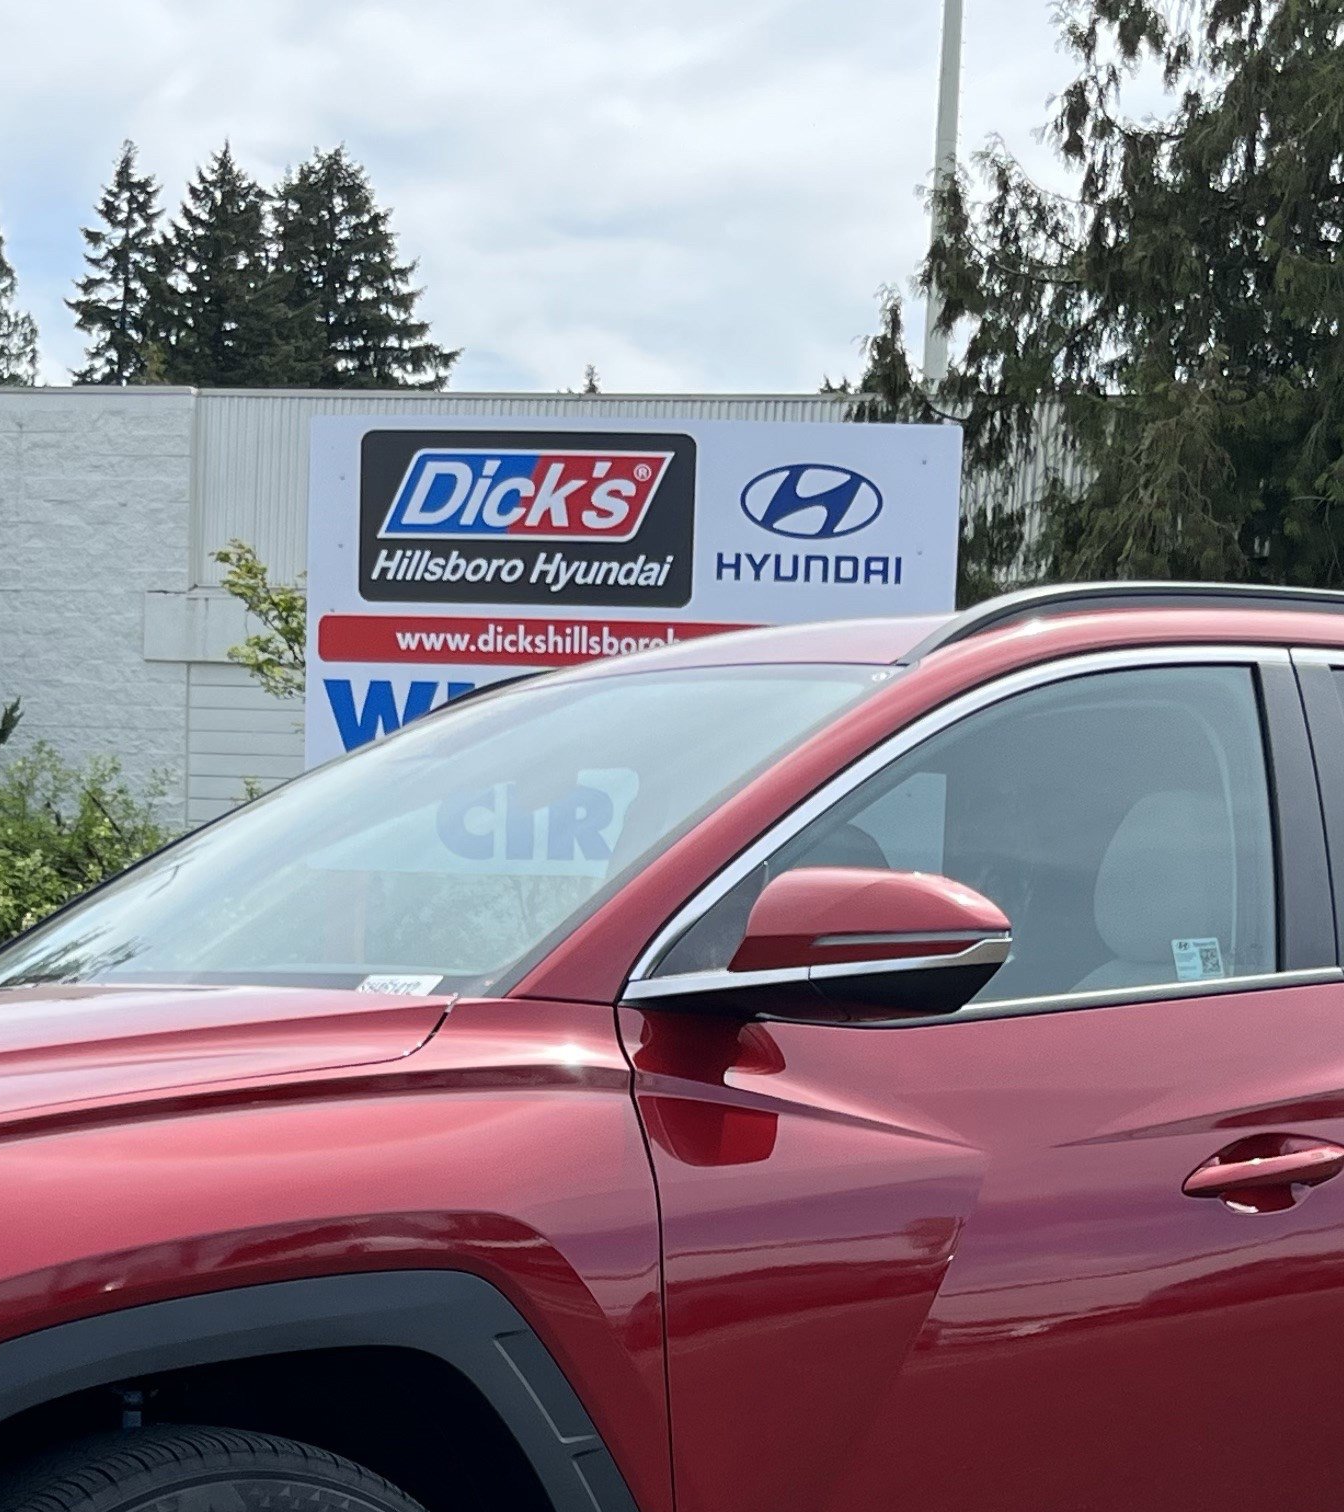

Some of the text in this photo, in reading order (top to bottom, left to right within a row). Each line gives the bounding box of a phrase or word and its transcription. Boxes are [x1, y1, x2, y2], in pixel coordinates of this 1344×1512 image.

[401, 458, 637, 530] Dick's
[371, 549, 674, 592] Hillsboro Hyundai
[716, 552, 902, 585] HYUNDAI
